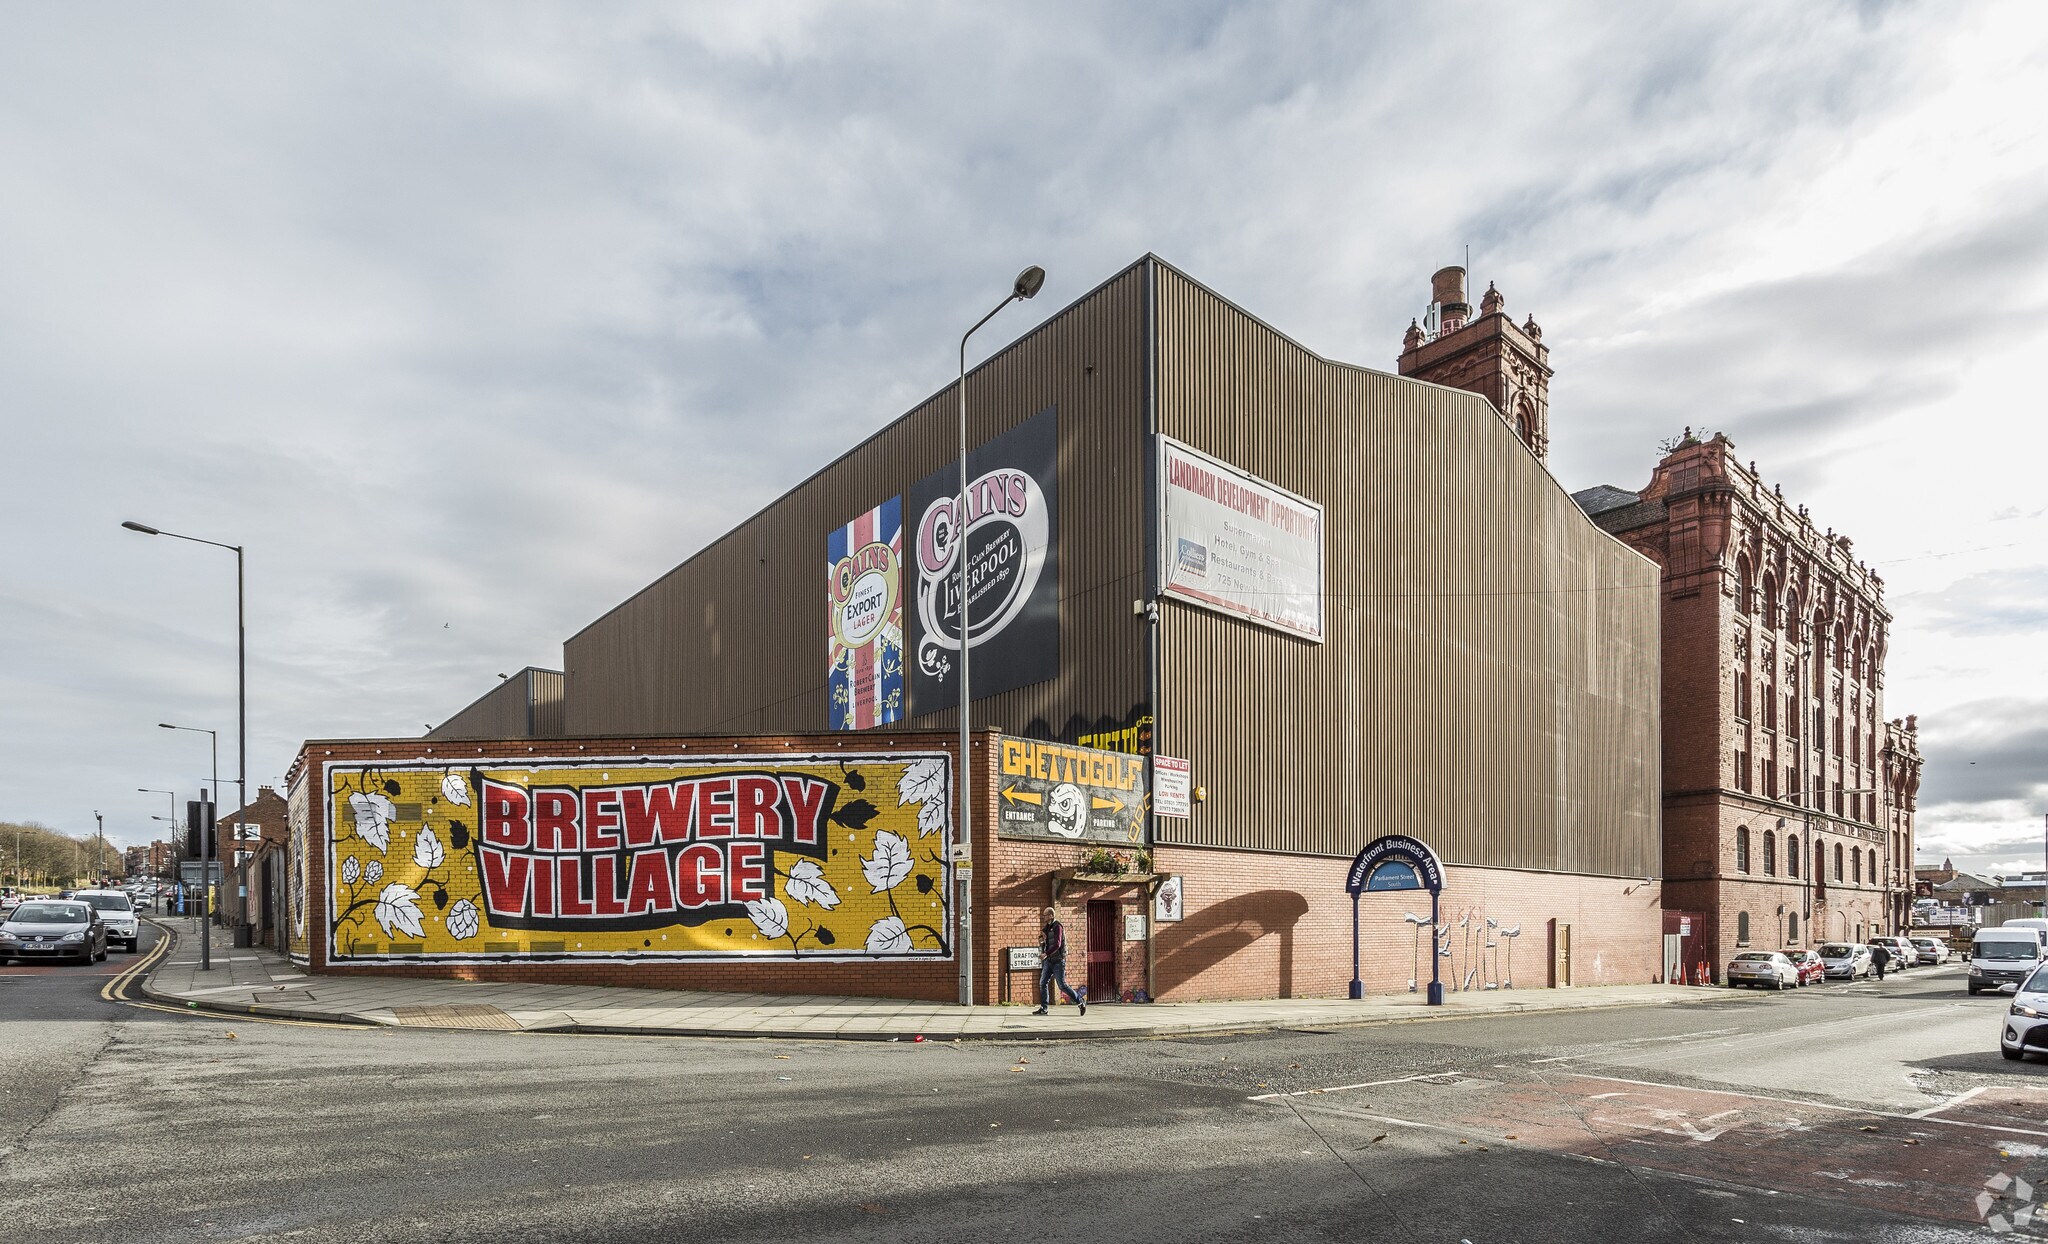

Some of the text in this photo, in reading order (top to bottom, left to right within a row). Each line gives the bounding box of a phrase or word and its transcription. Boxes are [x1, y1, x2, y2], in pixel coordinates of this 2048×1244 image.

[1169, 456, 1318, 544] LANDMARK DEVELOPMENT OPPORTUNITY
[921, 474, 1027, 572] CAINS
[1223, 521, 1272, 549] Supermart
[985, 528, 1011, 555] BREWERY
[1211, 552, 1257, 577] Restaurants
[1259, 570, 1264, 580] &
[1239, 545, 1257, 560] Gym
[1258, 552, 1264, 562] &
[1266, 555, 1280, 568] Spa
[833, 546, 889, 603] CAINS
[1217, 573, 1232, 587] 725
[855, 586, 873, 599] FINEST
[957, 567, 1010, 614] EABLISHED 1850
[847, 592, 882, 620] EXPORT
[853, 613, 875, 629] LAGER
[850, 676, 868, 688] ROBERT
[855, 684, 876, 696] BREWERY
[852, 696, 878, 708] LVERPOOL
[1002, 739, 1143, 791] GHETTOGOLF
[1155, 757, 1189, 770] SPACE TO LET
[1170, 792, 1186, 800] RENTS
[481, 774, 829, 852] BREWERY
[1005, 810, 1035, 822] ENTRANCE
[1093, 818, 1116, 829] PARKING
[1351, 839, 1437, 887] Waterfront Business Area
[478, 842, 766, 919] VILLAGE
